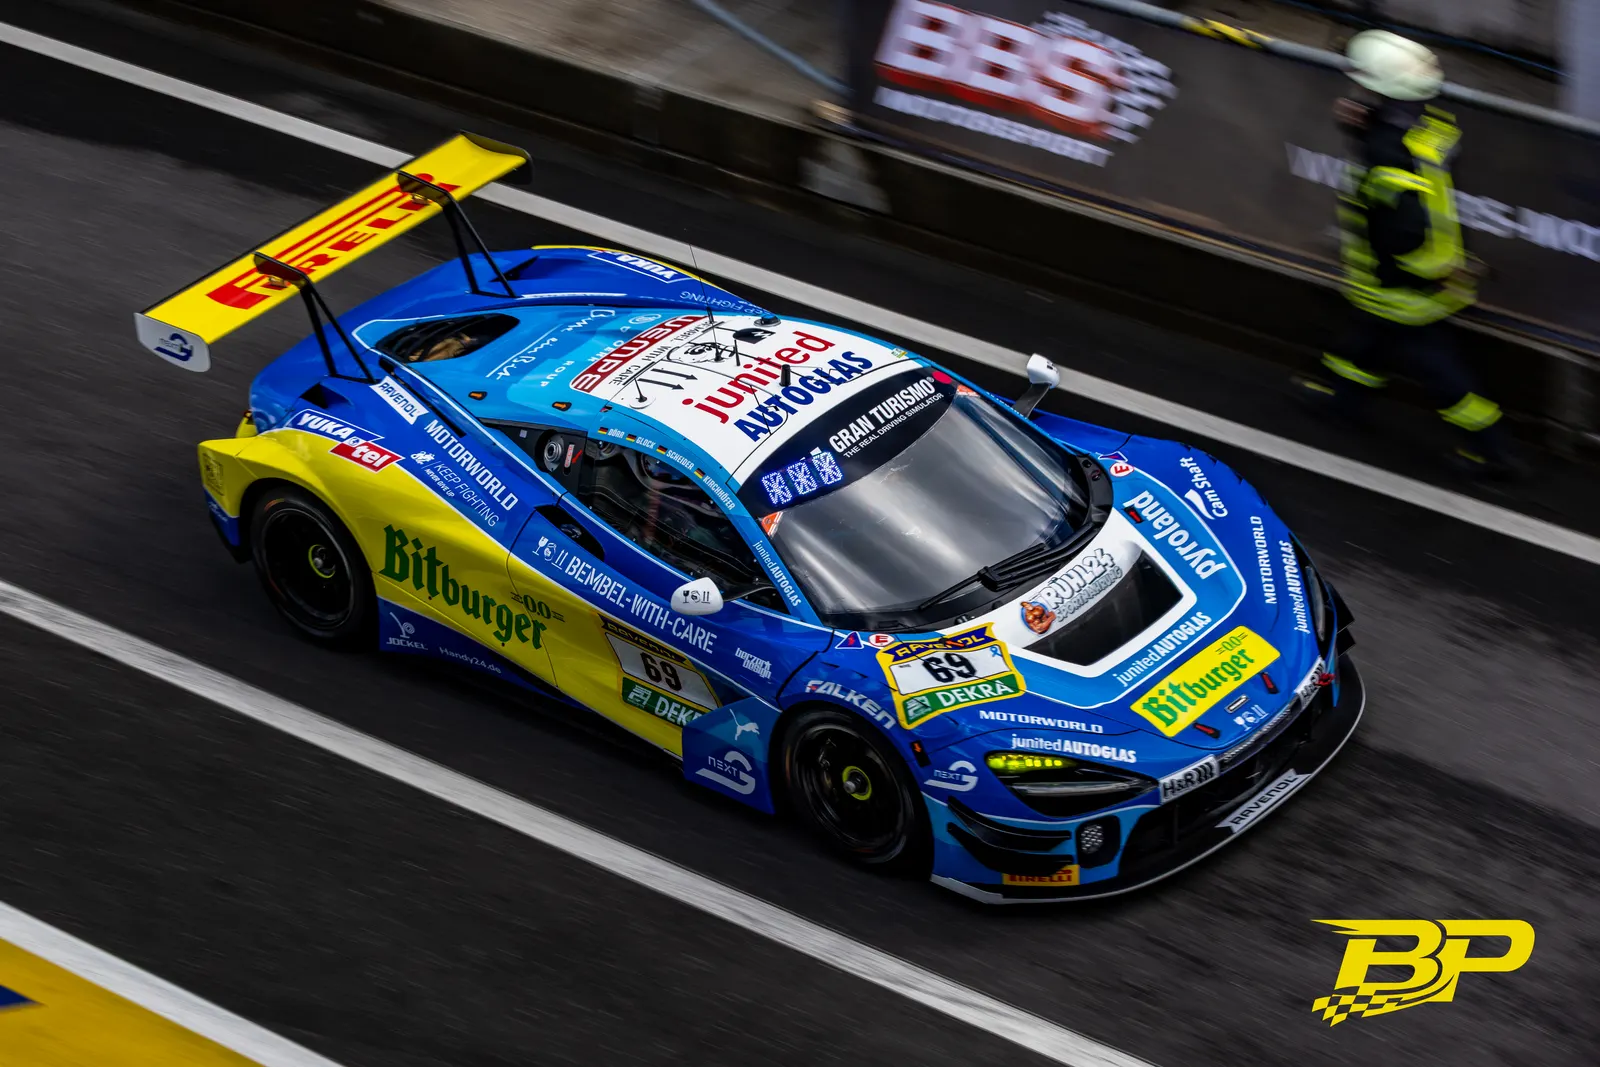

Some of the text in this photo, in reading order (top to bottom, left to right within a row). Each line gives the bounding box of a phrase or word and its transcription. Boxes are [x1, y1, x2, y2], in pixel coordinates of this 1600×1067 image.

[873, 0, 1114, 134] BBS
[574, 316, 698, 392] WEMPE
[641, 344, 669, 362] WITH
[608, 364, 641, 386] CARE
[682, 330, 836, 424] junited
[378, 380, 418, 418] RAVENOL
[733, 350, 874, 442] AUTOGLAS
[297, 413, 356, 440] YUKA
[635, 436, 656, 450] GLOCK
[828, 414, 876, 453] GRAN
[843, 392, 945, 459] THE REAL DRIVING SIMULATOR
[351, 445, 391, 468] tel
[424, 419, 519, 511] MOTORWORLD
[666, 449, 695, 470] SCHEIDER
[424, 468, 455, 497] NEVER GIVE UP
[434, 463, 500, 527] KEEP FIGHTING
[702, 475, 736, 511] KIRCHHÖFER
[1123, 490, 1227, 580] pyroland
[1038, 548, 1116, 610] RÜHL24
[1250, 515, 1278, 605] MOTORWORLD
[378, 524, 548, 650] Bitburger
[1056, 565, 1124, 623] SPORTNAHRUNG
[386, 637, 428, 651] JOCKEL
[640, 652, 682, 692] 69
[922, 652, 977, 683] 69
[804, 679, 897, 730] FALKEN
[935, 680, 1015, 707] DEKRA
[1141, 649, 1256, 728] Bitburger
[654, 696, 703, 727] DEK
[979, 709, 1104, 735] MOTORWORLD
[1230, 774, 1300, 828] RAVENOL
